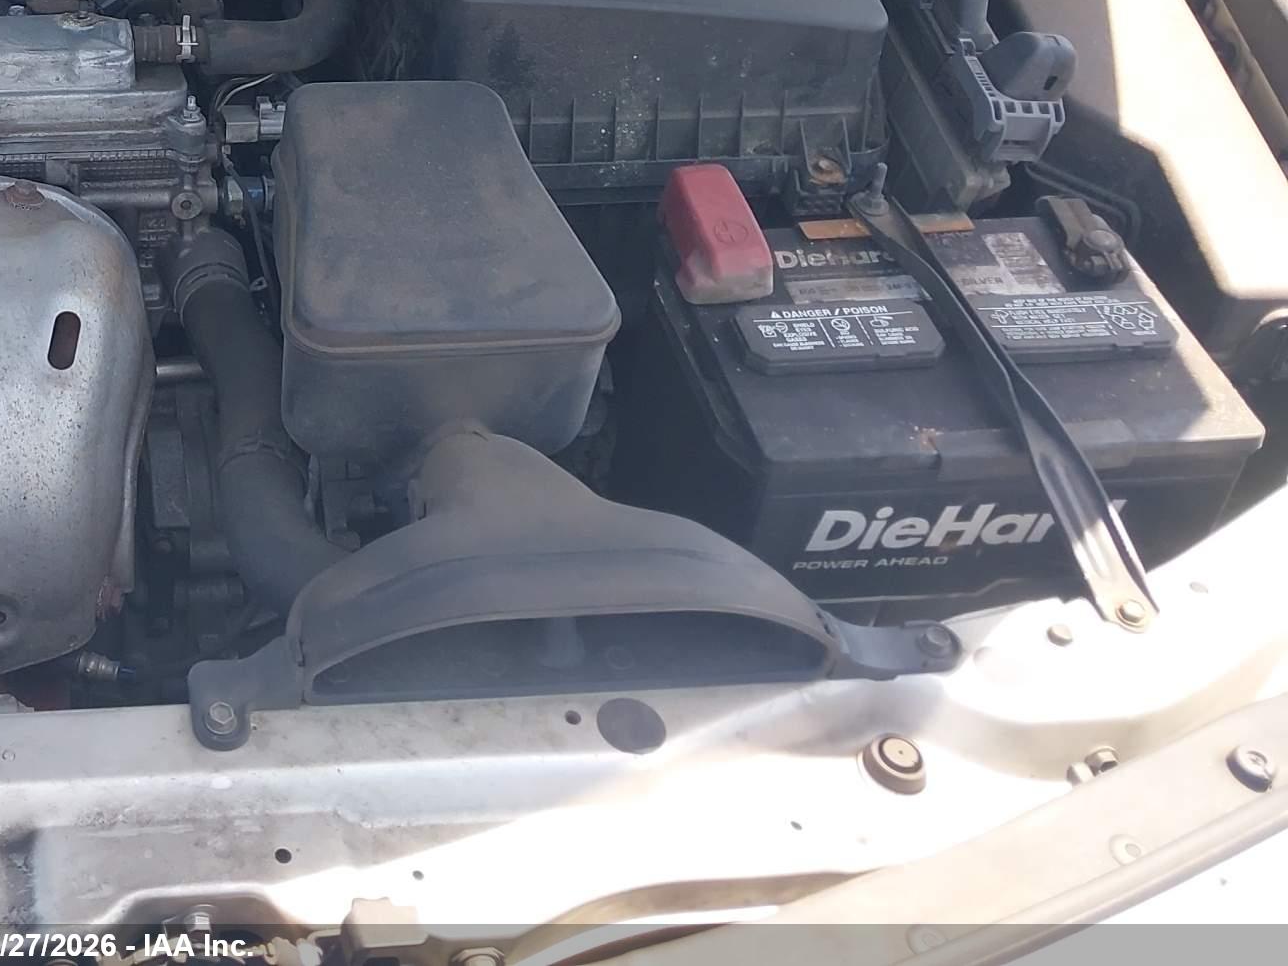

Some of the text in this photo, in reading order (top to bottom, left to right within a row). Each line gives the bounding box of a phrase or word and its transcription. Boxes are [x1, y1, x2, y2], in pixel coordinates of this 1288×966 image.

[782, 309, 832, 318] DANGER
[842, 305, 888, 315] POISON
[805, 498, 1128, 552] DieHar
[792, 555, 949, 571] POWER AHEAD
